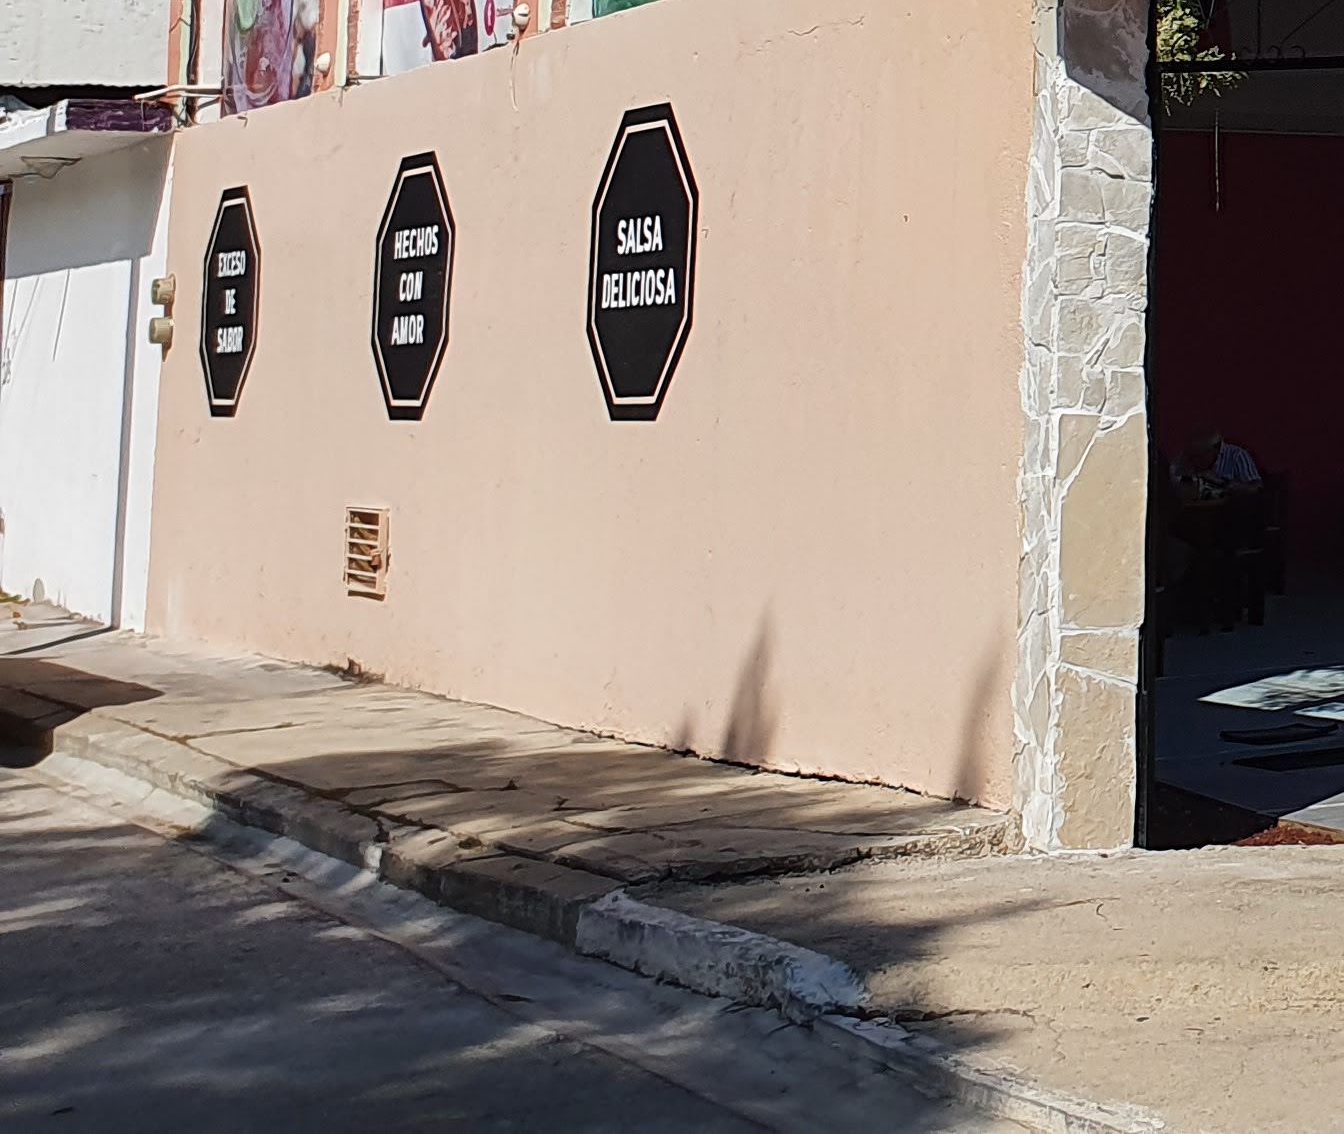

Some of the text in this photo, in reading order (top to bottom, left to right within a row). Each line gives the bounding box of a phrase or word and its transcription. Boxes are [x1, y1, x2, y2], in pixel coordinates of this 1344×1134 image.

[394, 225, 439, 259] HECHOS
[617, 215, 664, 255] SALSA
[217, 250, 246, 278] EXCESO
[399, 271, 423, 301] CON
[601, 267, 676, 309] DELICIOSA
[225, 288, 236, 315] DE
[216, 325, 243, 354] SABOR
[391, 315, 424, 346] AMOR
